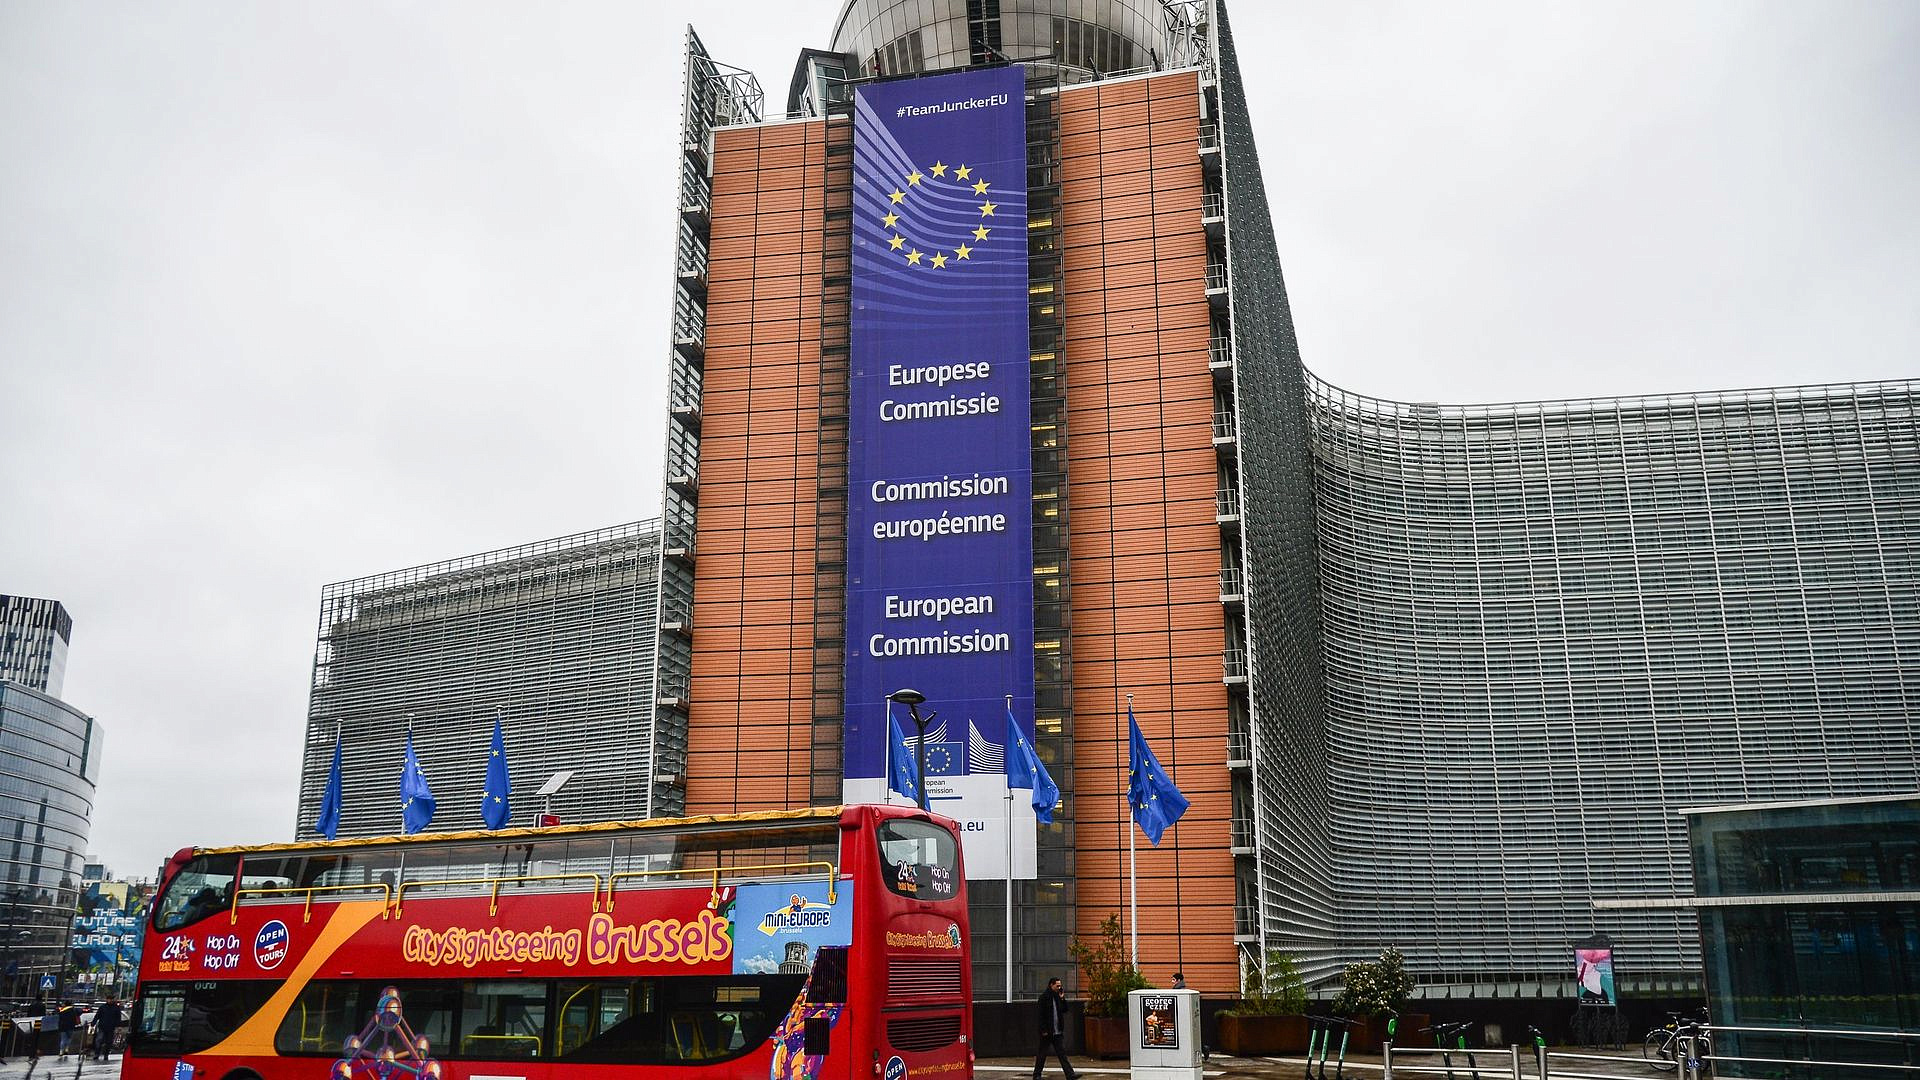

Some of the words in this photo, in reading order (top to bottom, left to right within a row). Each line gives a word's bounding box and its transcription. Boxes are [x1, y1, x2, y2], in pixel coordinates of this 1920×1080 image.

[896, 93, 1008, 118] #TeamJunckerEU
[889, 361, 990, 387] Europese
[879, 392, 1000, 421] Commissie
[871, 473, 1008, 502] Commission
[873, 510, 1006, 541] européenne
[885, 595, 993, 621] European
[869, 629, 1009, 657] Commission
[897, 861, 908, 880] 24
[931, 866, 941, 878] Hop
[942, 867, 950, 879] On
[932, 880, 942, 893] Hop
[92, 908, 118, 917] THE
[206, 935, 225, 950] Hop
[226, 934, 240, 949] On
[259, 928, 285, 943] OPEN
[587, 909, 732, 965] Brussels
[162, 936, 181, 959] 24
[259, 949, 284, 964] TOURS
[203, 954, 222, 970] Hop
[224, 953, 240, 968] Off
[1145, 998, 1173, 1006] george
[886, 1062, 903, 1078] OPEN
